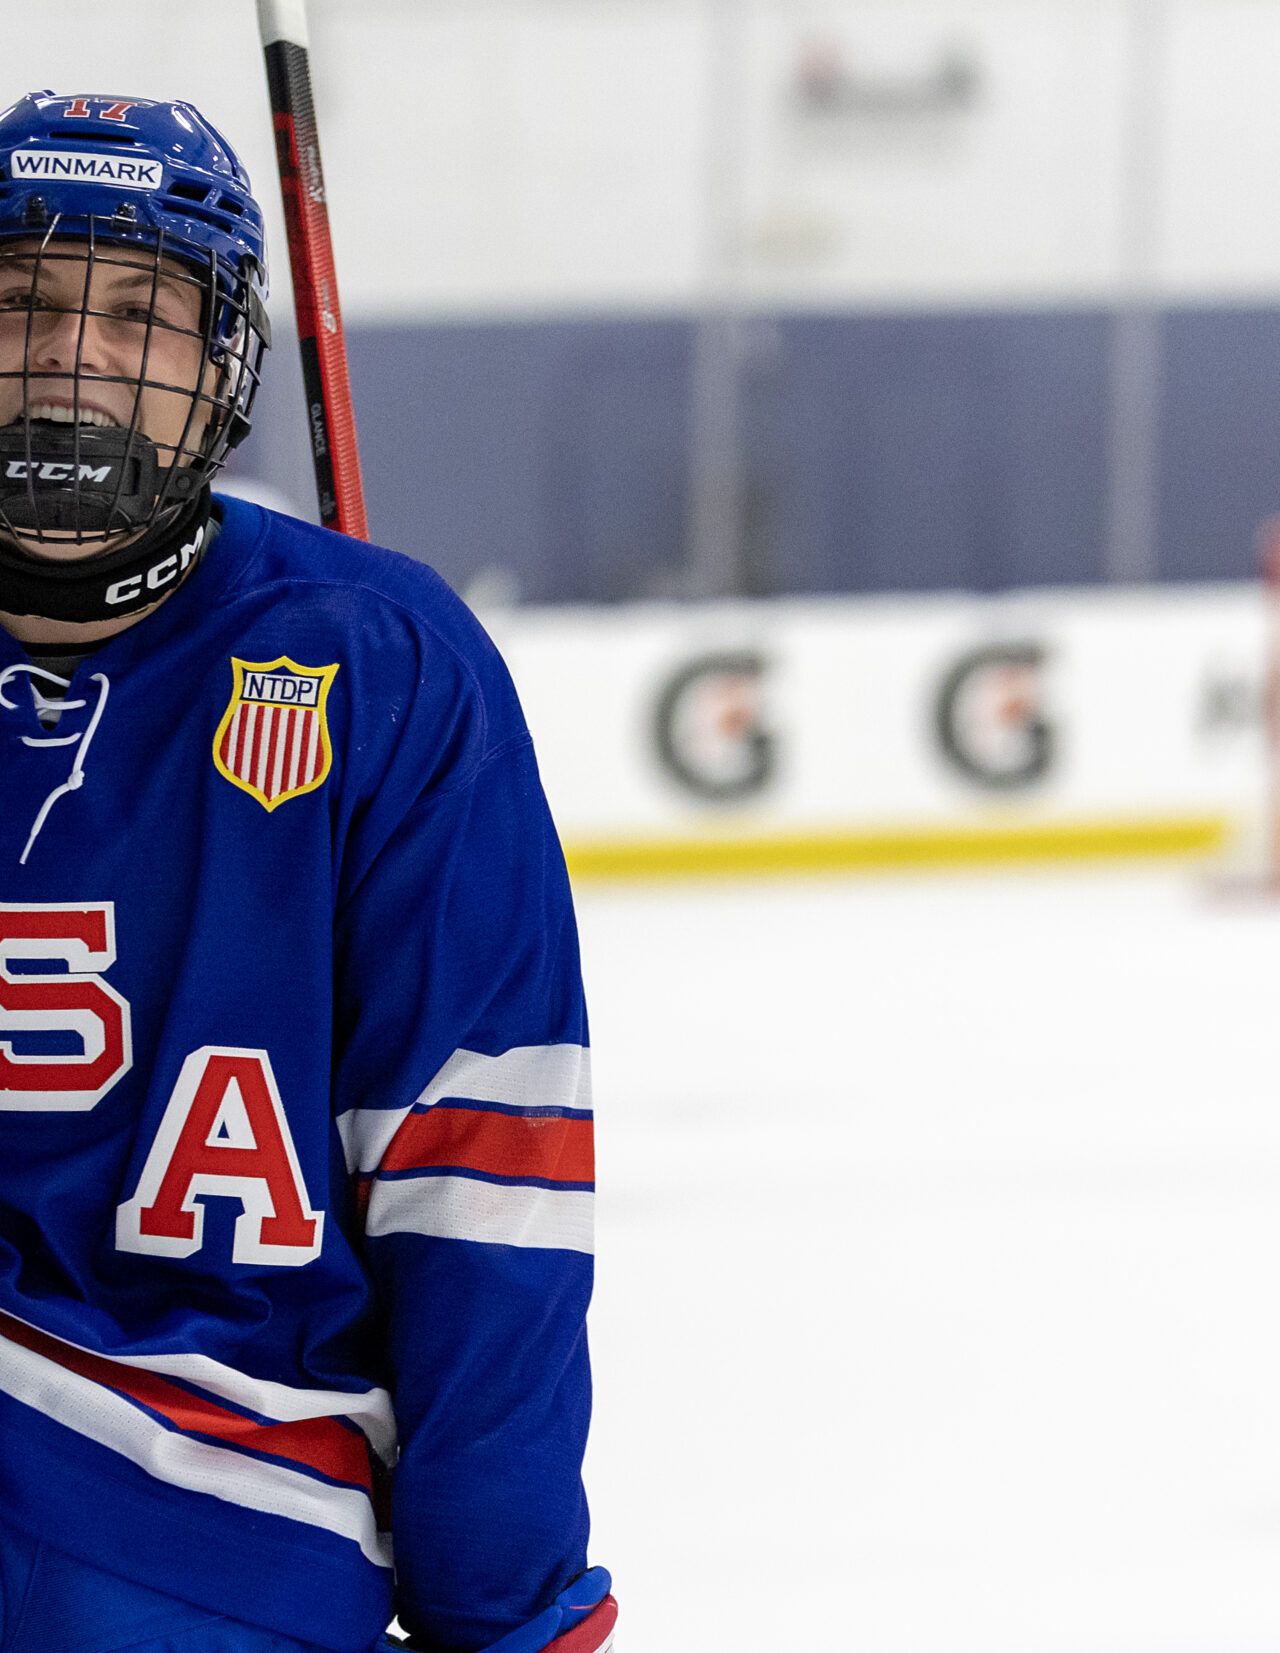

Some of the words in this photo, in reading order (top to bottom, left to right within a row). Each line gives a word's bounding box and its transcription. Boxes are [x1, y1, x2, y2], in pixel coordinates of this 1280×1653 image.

[64, 98, 138, 122] 17
[16, 156, 158, 183] WINMARK
[6, 461, 112, 482] CCM
[105, 526, 204, 605] CCM
[248, 675, 313, 702] NTDP
